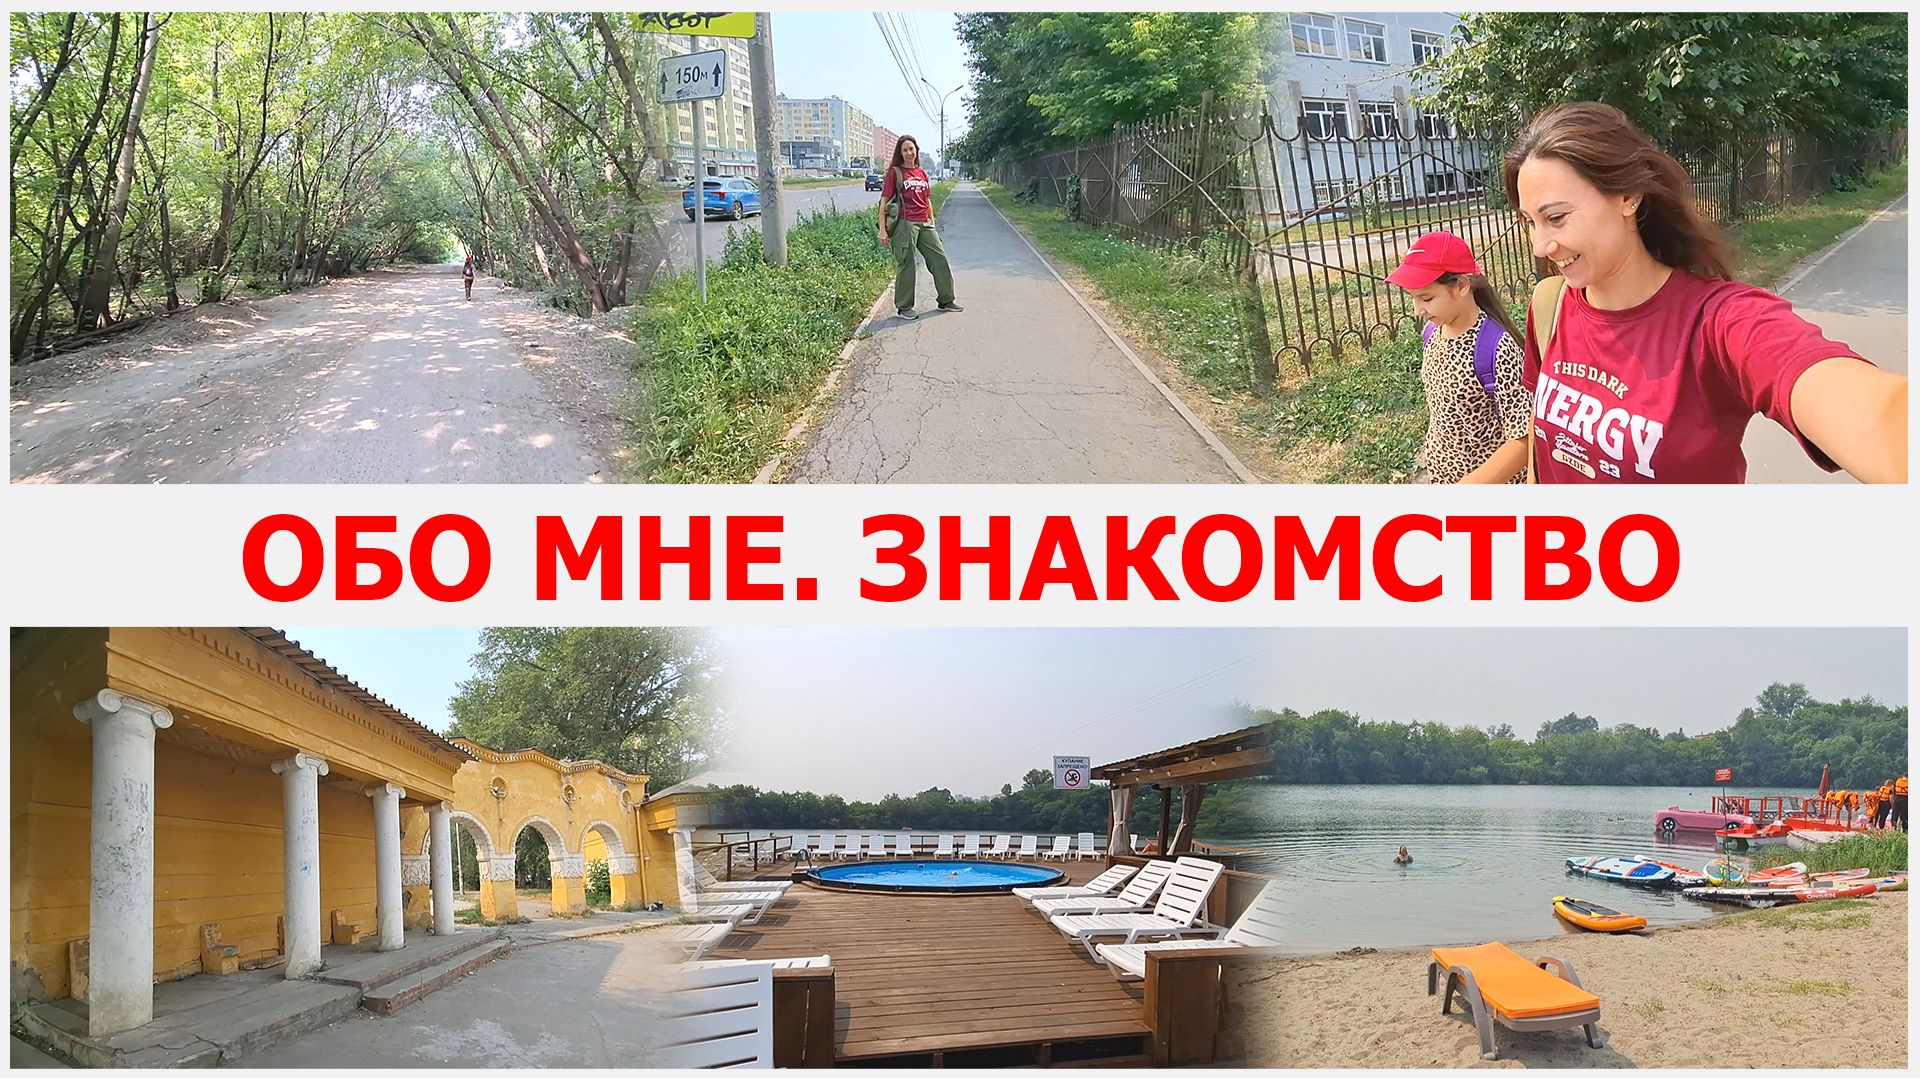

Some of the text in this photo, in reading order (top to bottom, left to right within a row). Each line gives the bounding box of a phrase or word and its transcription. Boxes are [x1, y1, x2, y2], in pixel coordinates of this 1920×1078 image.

[1553, 360, 1629, 400] THIS DARK
[1534, 372, 1664, 479] NERGY
[1599, 459, 1621, 478] 23
